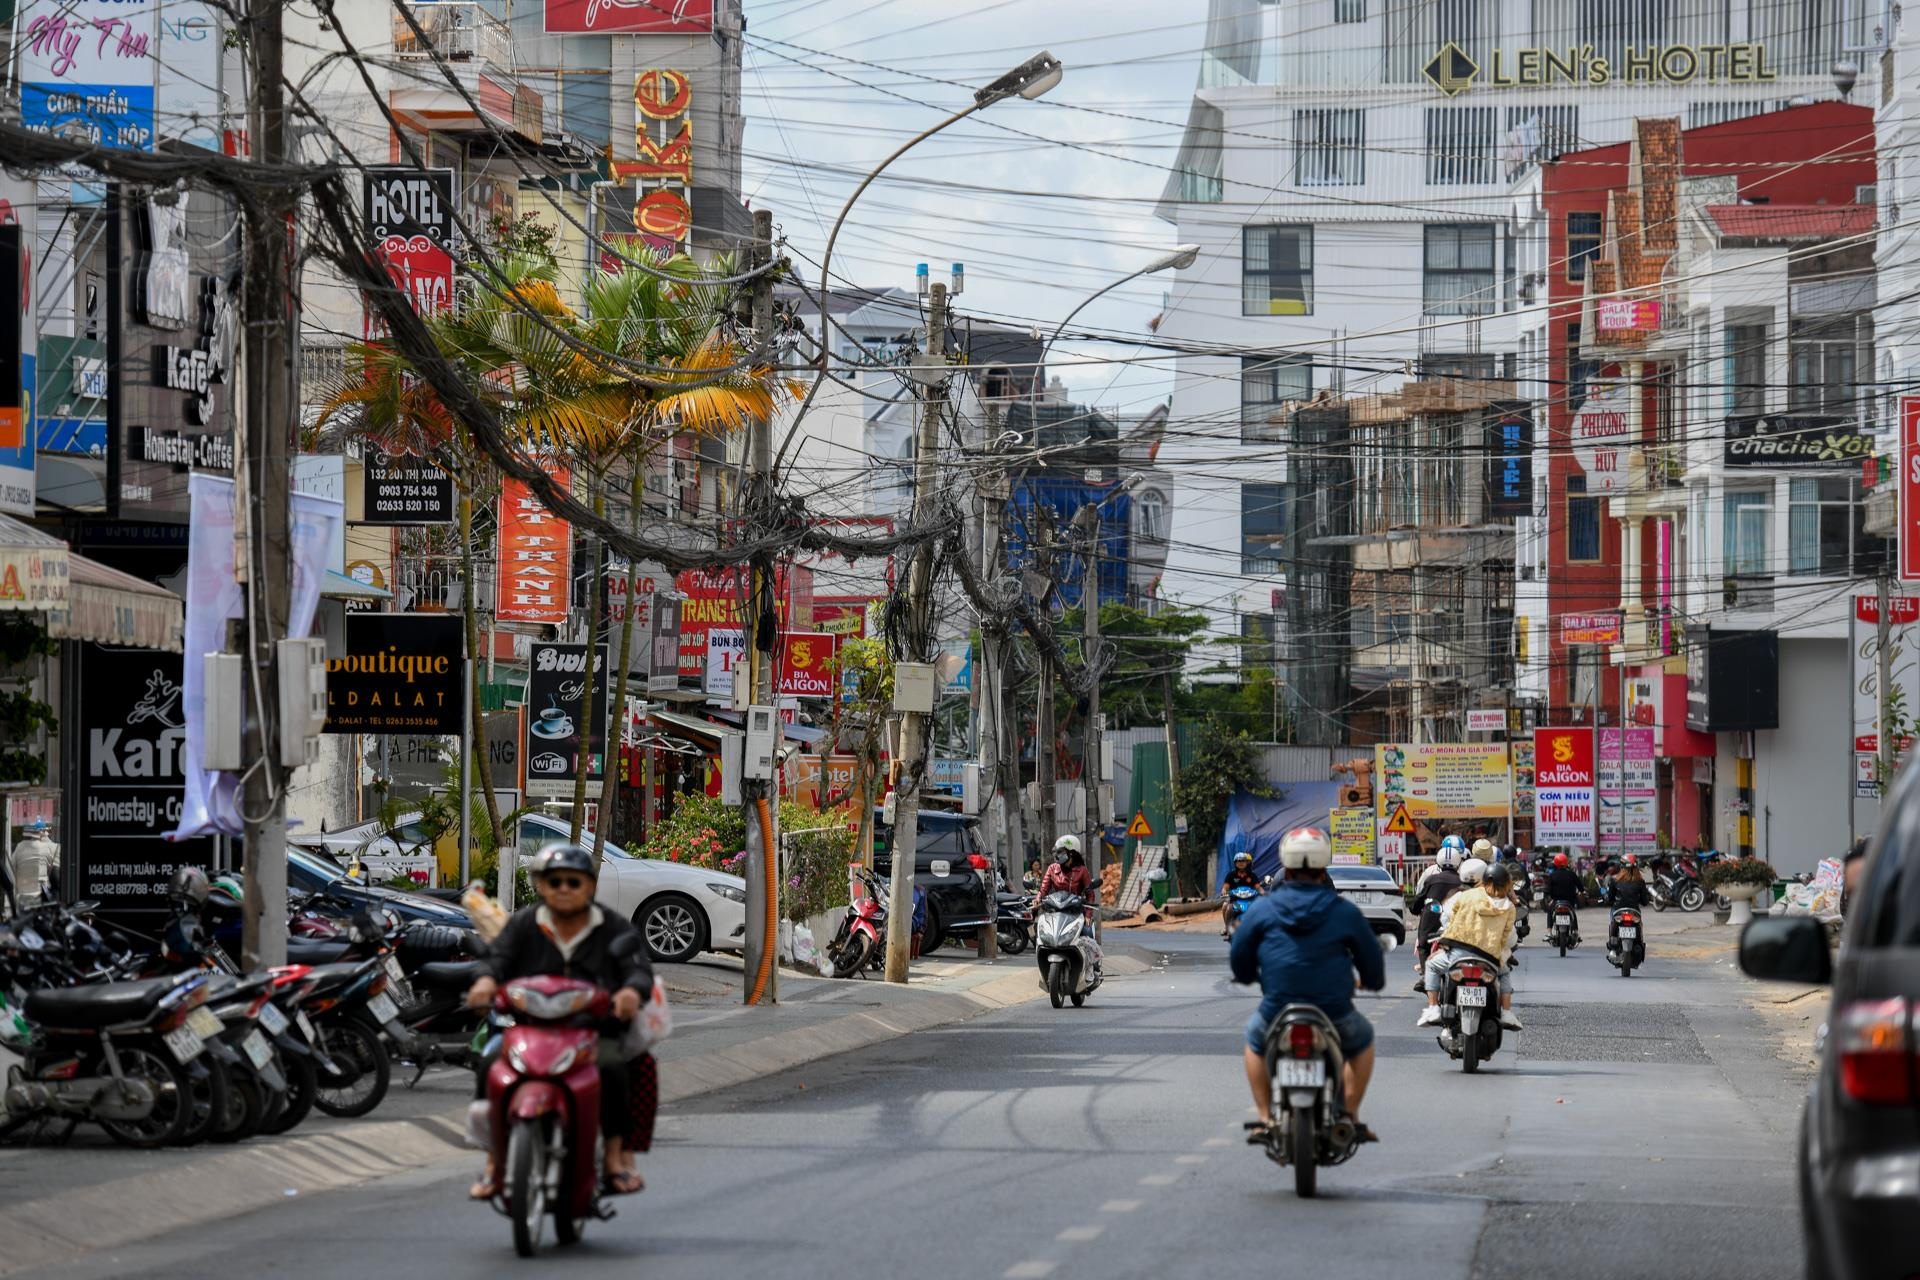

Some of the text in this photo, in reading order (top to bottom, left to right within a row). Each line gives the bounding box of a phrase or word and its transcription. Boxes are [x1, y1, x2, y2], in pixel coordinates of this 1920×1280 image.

[27, 15, 81, 77] Mỹ
[1626, 44, 1778, 85] HOTEL
[371, 179, 443, 225] HOTEL
[371, 469, 386, 480] 132
[421, 466, 447, 480] XUÂN
[379, 485, 438, 497] 0903 754 343
[376, 500, 441, 512] 02633 520 150
[1862, 598, 1915, 612] HTEL
[793, 671, 810, 680] BIA
[338, 717, 363, 725] DALAT
[405, 717, 423, 726] 3535
[425, 717, 438, 726] 456
[90, 728, 186, 777] Kaf
[1556, 764, 1572, 772] BIA
[1629, 761, 1651, 770] TOUR
[1539, 771, 1589, 783] SAIGON
[88, 796, 155, 828] Homestay
[1540, 802, 1564, 827] VIỆT
[1566, 804, 1591, 823] NAM
[104, 862, 119, 876] BÙI
[133, 862, 156, 876] XUÂN
[116, 883, 148, 895] 887788
